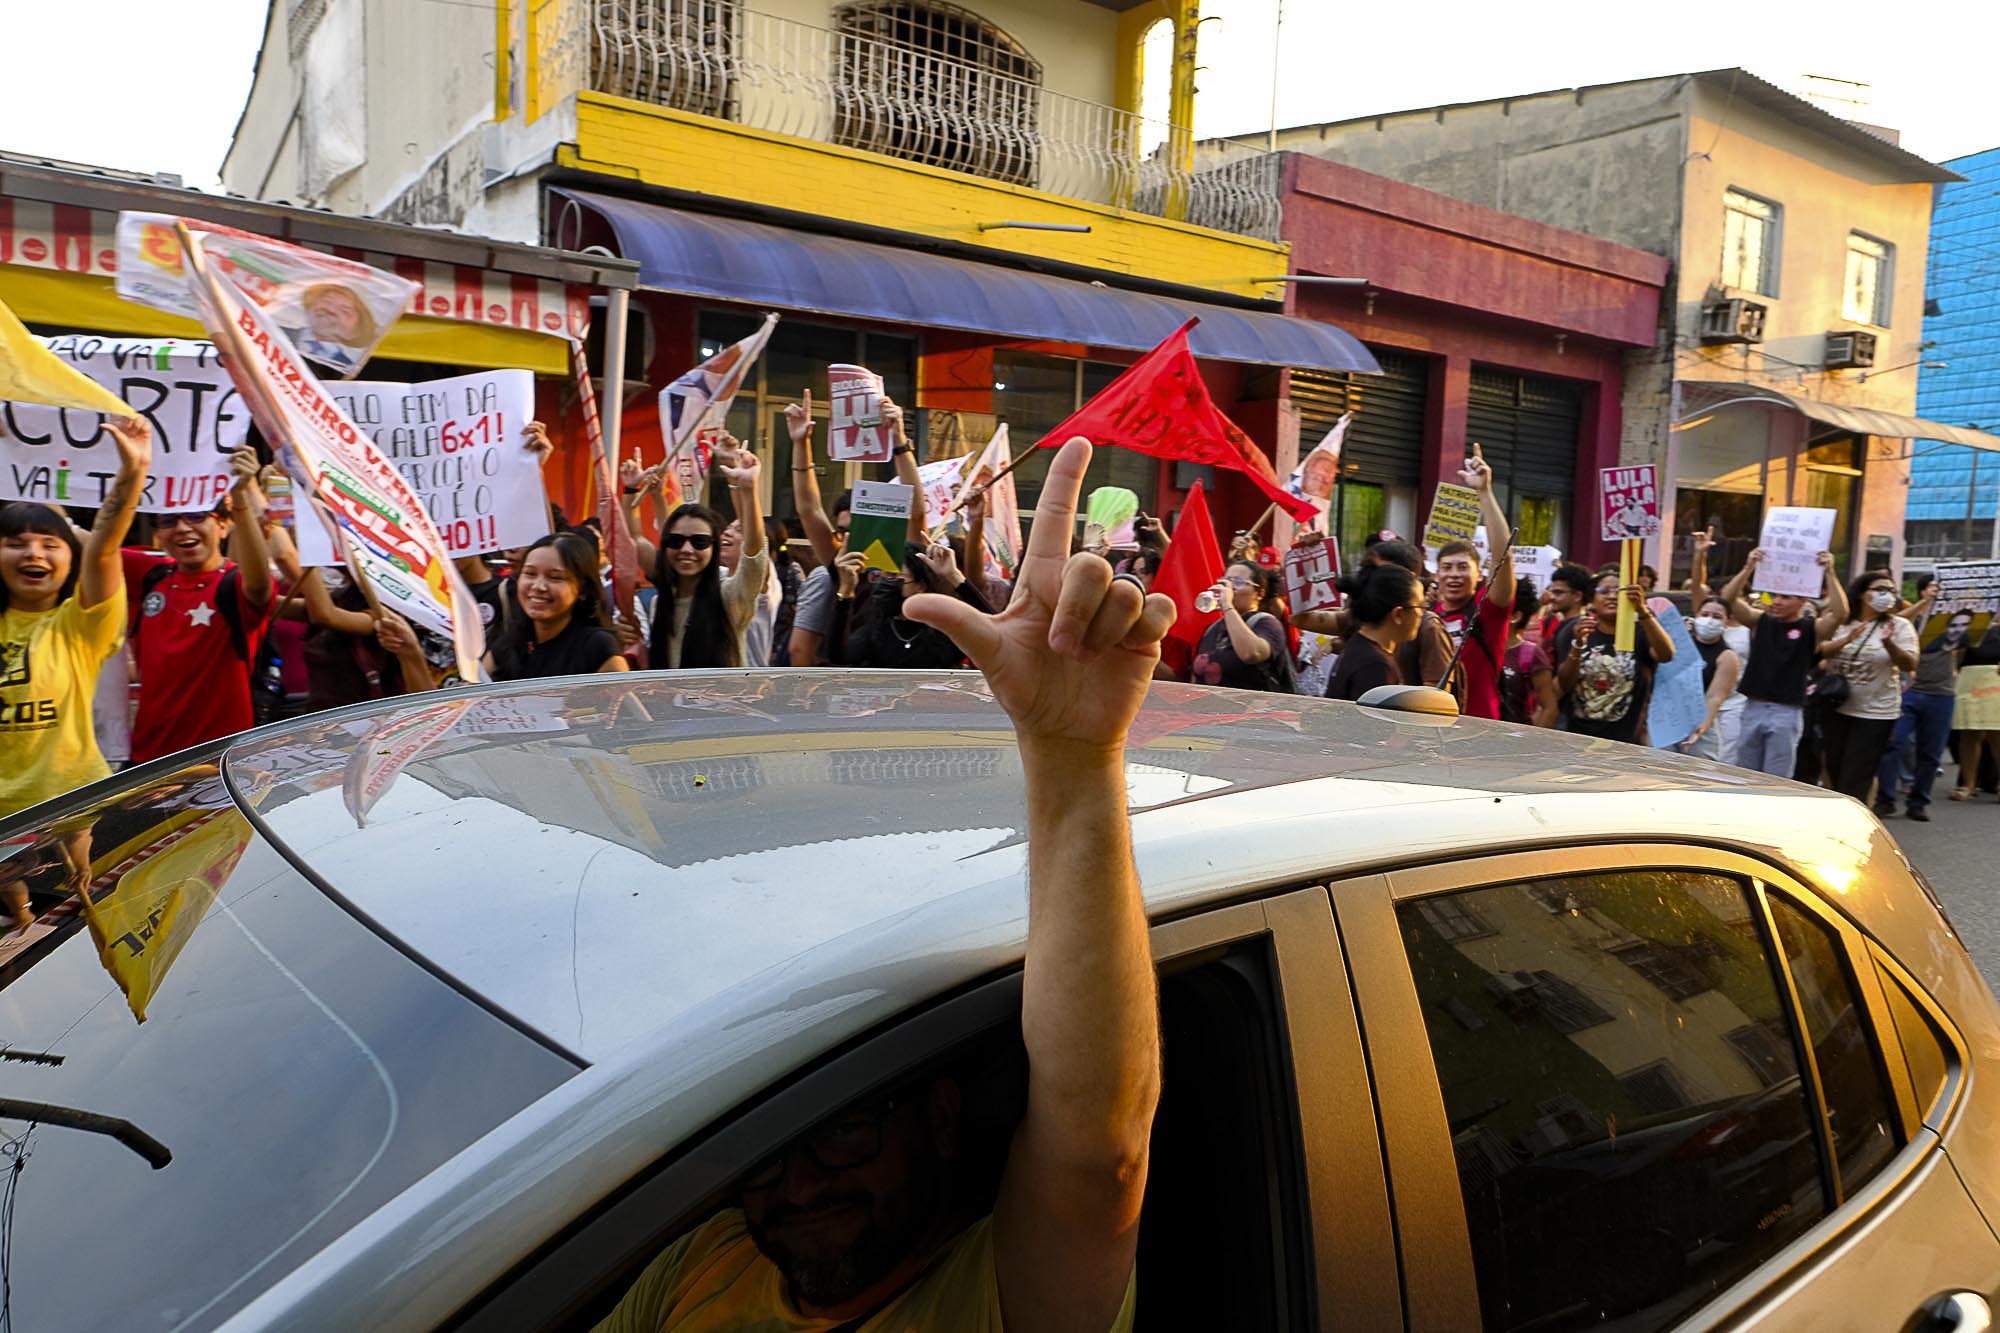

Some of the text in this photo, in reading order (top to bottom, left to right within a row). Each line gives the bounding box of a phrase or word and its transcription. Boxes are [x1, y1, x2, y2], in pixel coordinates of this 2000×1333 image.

[237, 307, 358, 445] BANZEIRO
[5, 373, 237, 454] CORTE
[401, 393, 450, 424] FIM
[465, 382, 498, 417] DA
[832, 425, 883, 459] LA
[87, 471, 156, 505] TR
[1604, 467, 1653, 492] LULA
[1608, 493, 1625, 508] 13
[319, 477, 427, 568] LULA
[1288, 581, 1337, 616] LA
